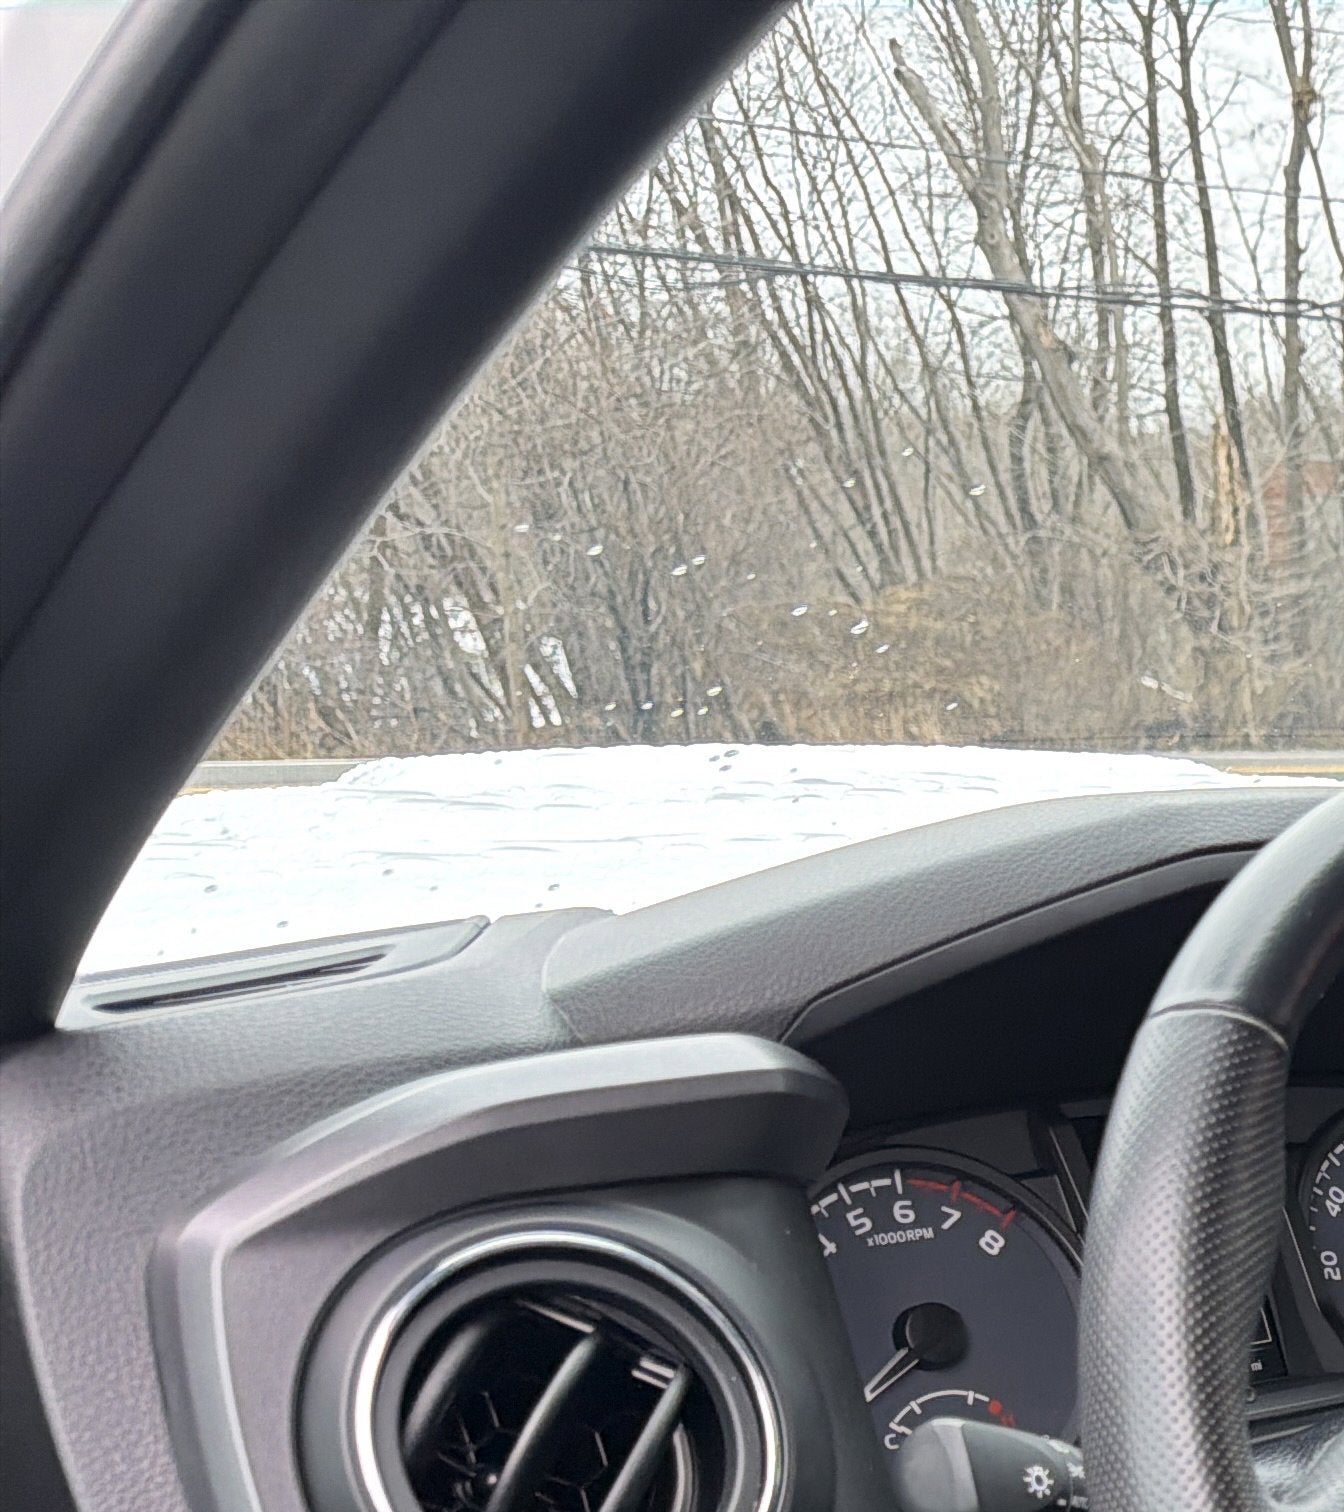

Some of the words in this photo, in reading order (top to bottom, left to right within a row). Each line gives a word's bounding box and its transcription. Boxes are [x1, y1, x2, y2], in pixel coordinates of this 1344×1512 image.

[846, 1207, 873, 1236] 5
[893, 1200, 916, 1223] 6
[940, 1205, 962, 1230] 7
[867, 1227, 935, 1247] x1000RPM
[978, 1229, 1006, 1256] 8
[1320, 1251, 1341, 1281] 20
[884, 1433, 900, 1450] C
